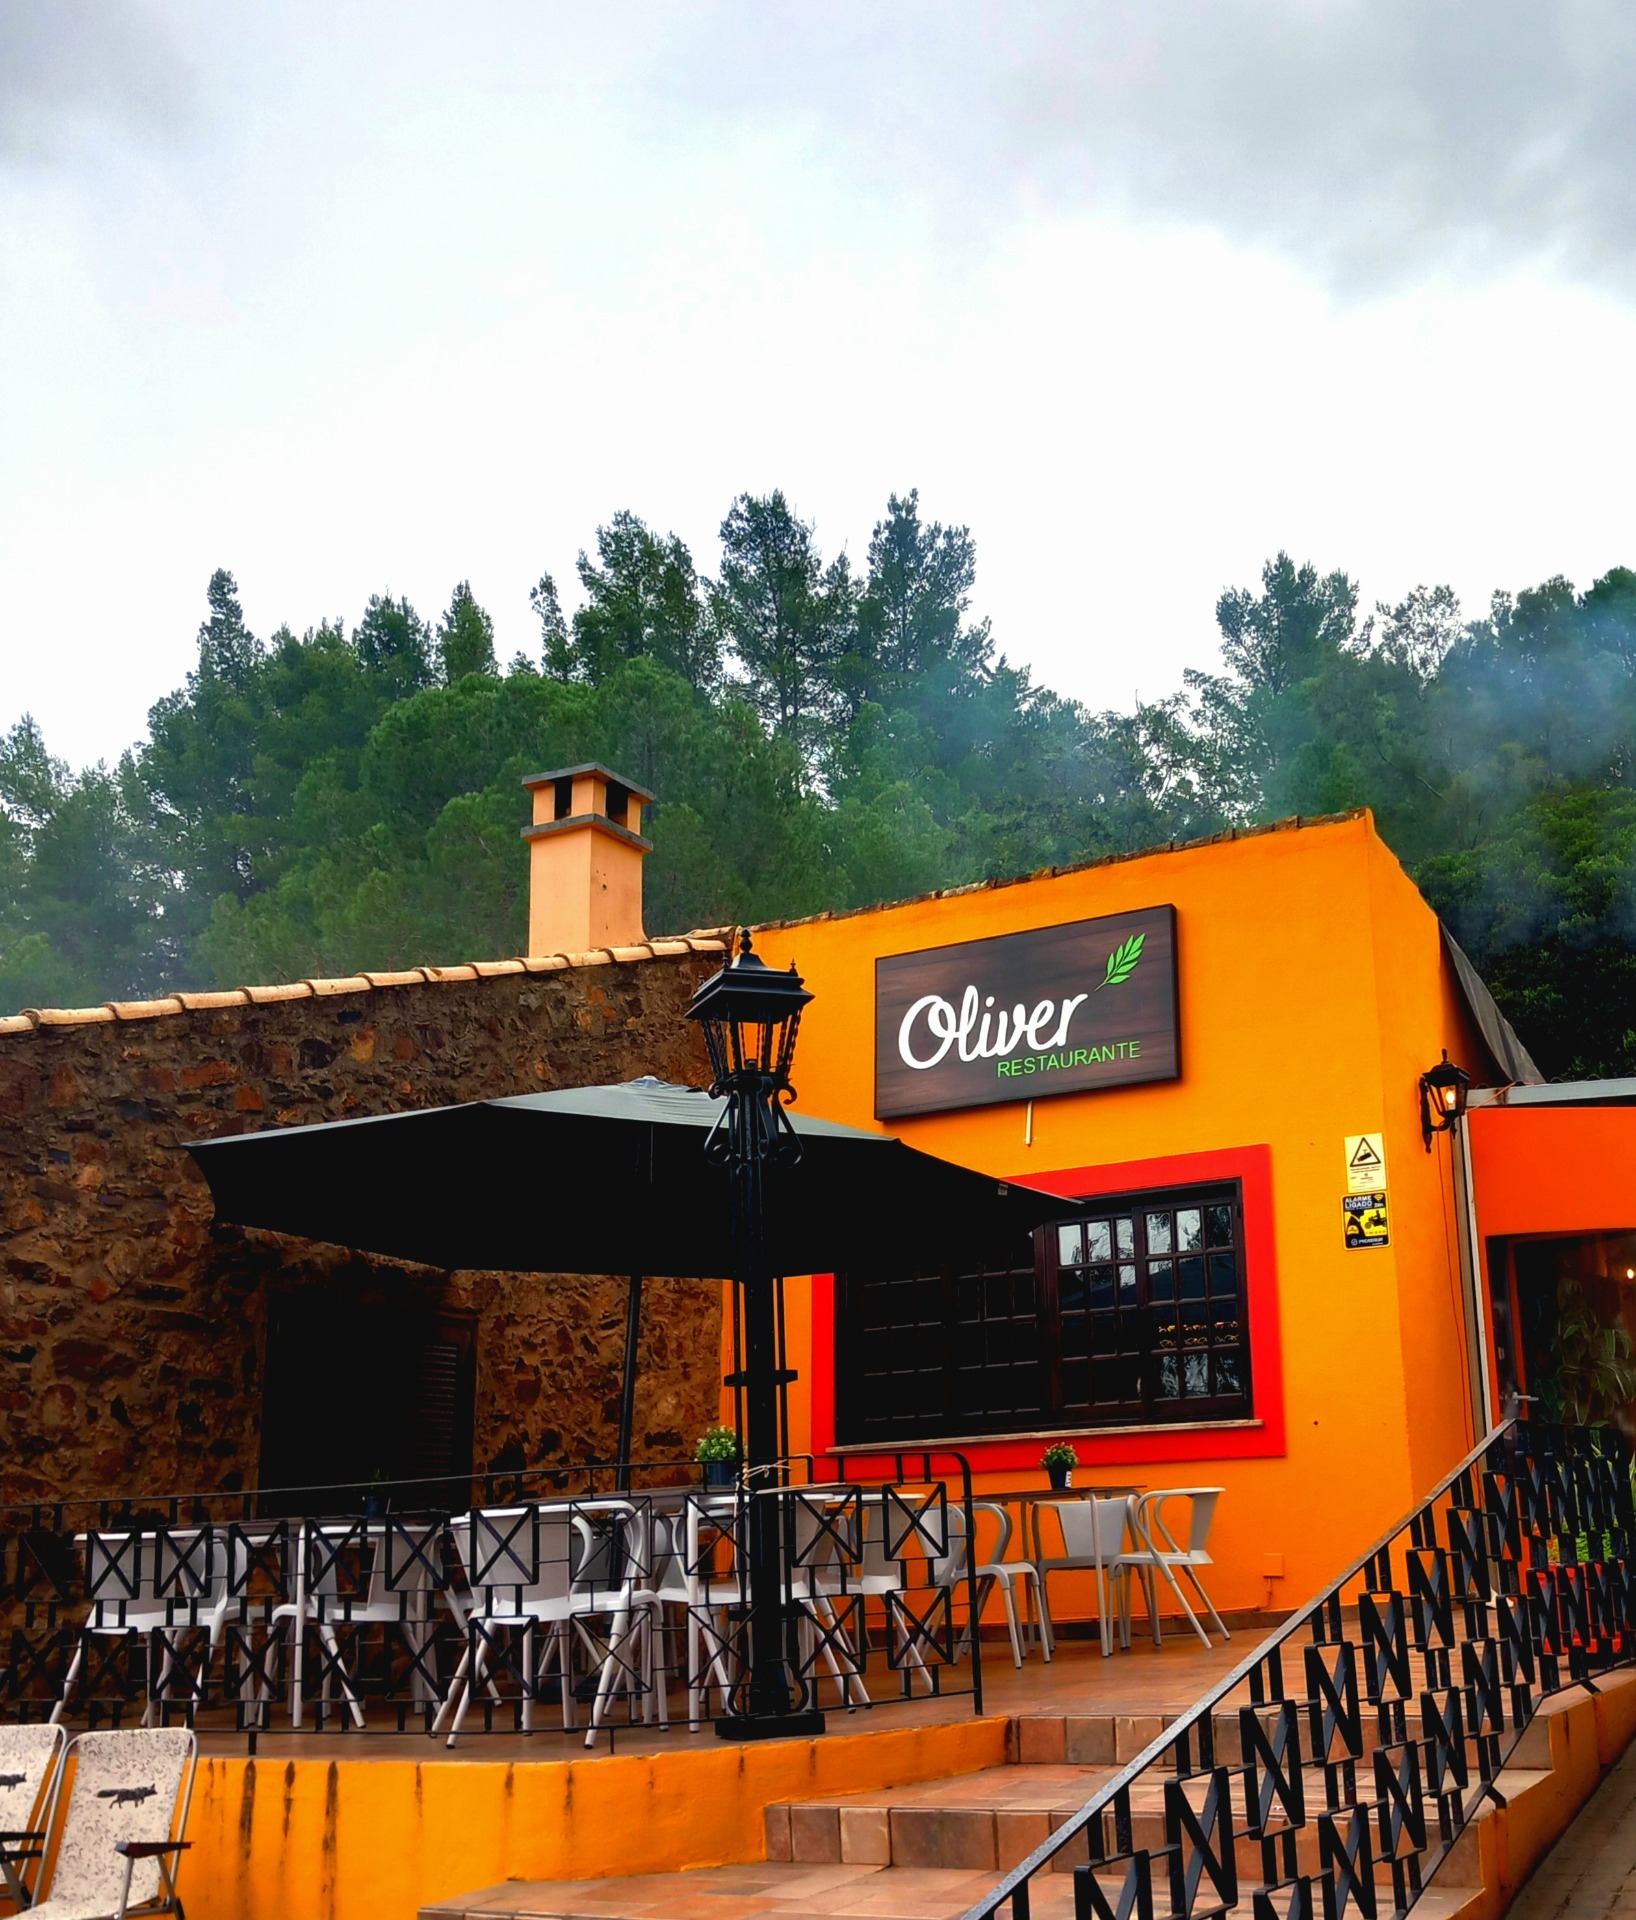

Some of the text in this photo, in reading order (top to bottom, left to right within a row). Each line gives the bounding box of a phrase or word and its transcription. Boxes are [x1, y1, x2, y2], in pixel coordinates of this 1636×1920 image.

[898, 985, 1088, 1070] Oliver
[997, 1041, 1141, 1079] RESTAURANTE
[1345, 1195, 1372, 1203] ALARME
[1345, 1201, 1373, 1209] LIGADO
